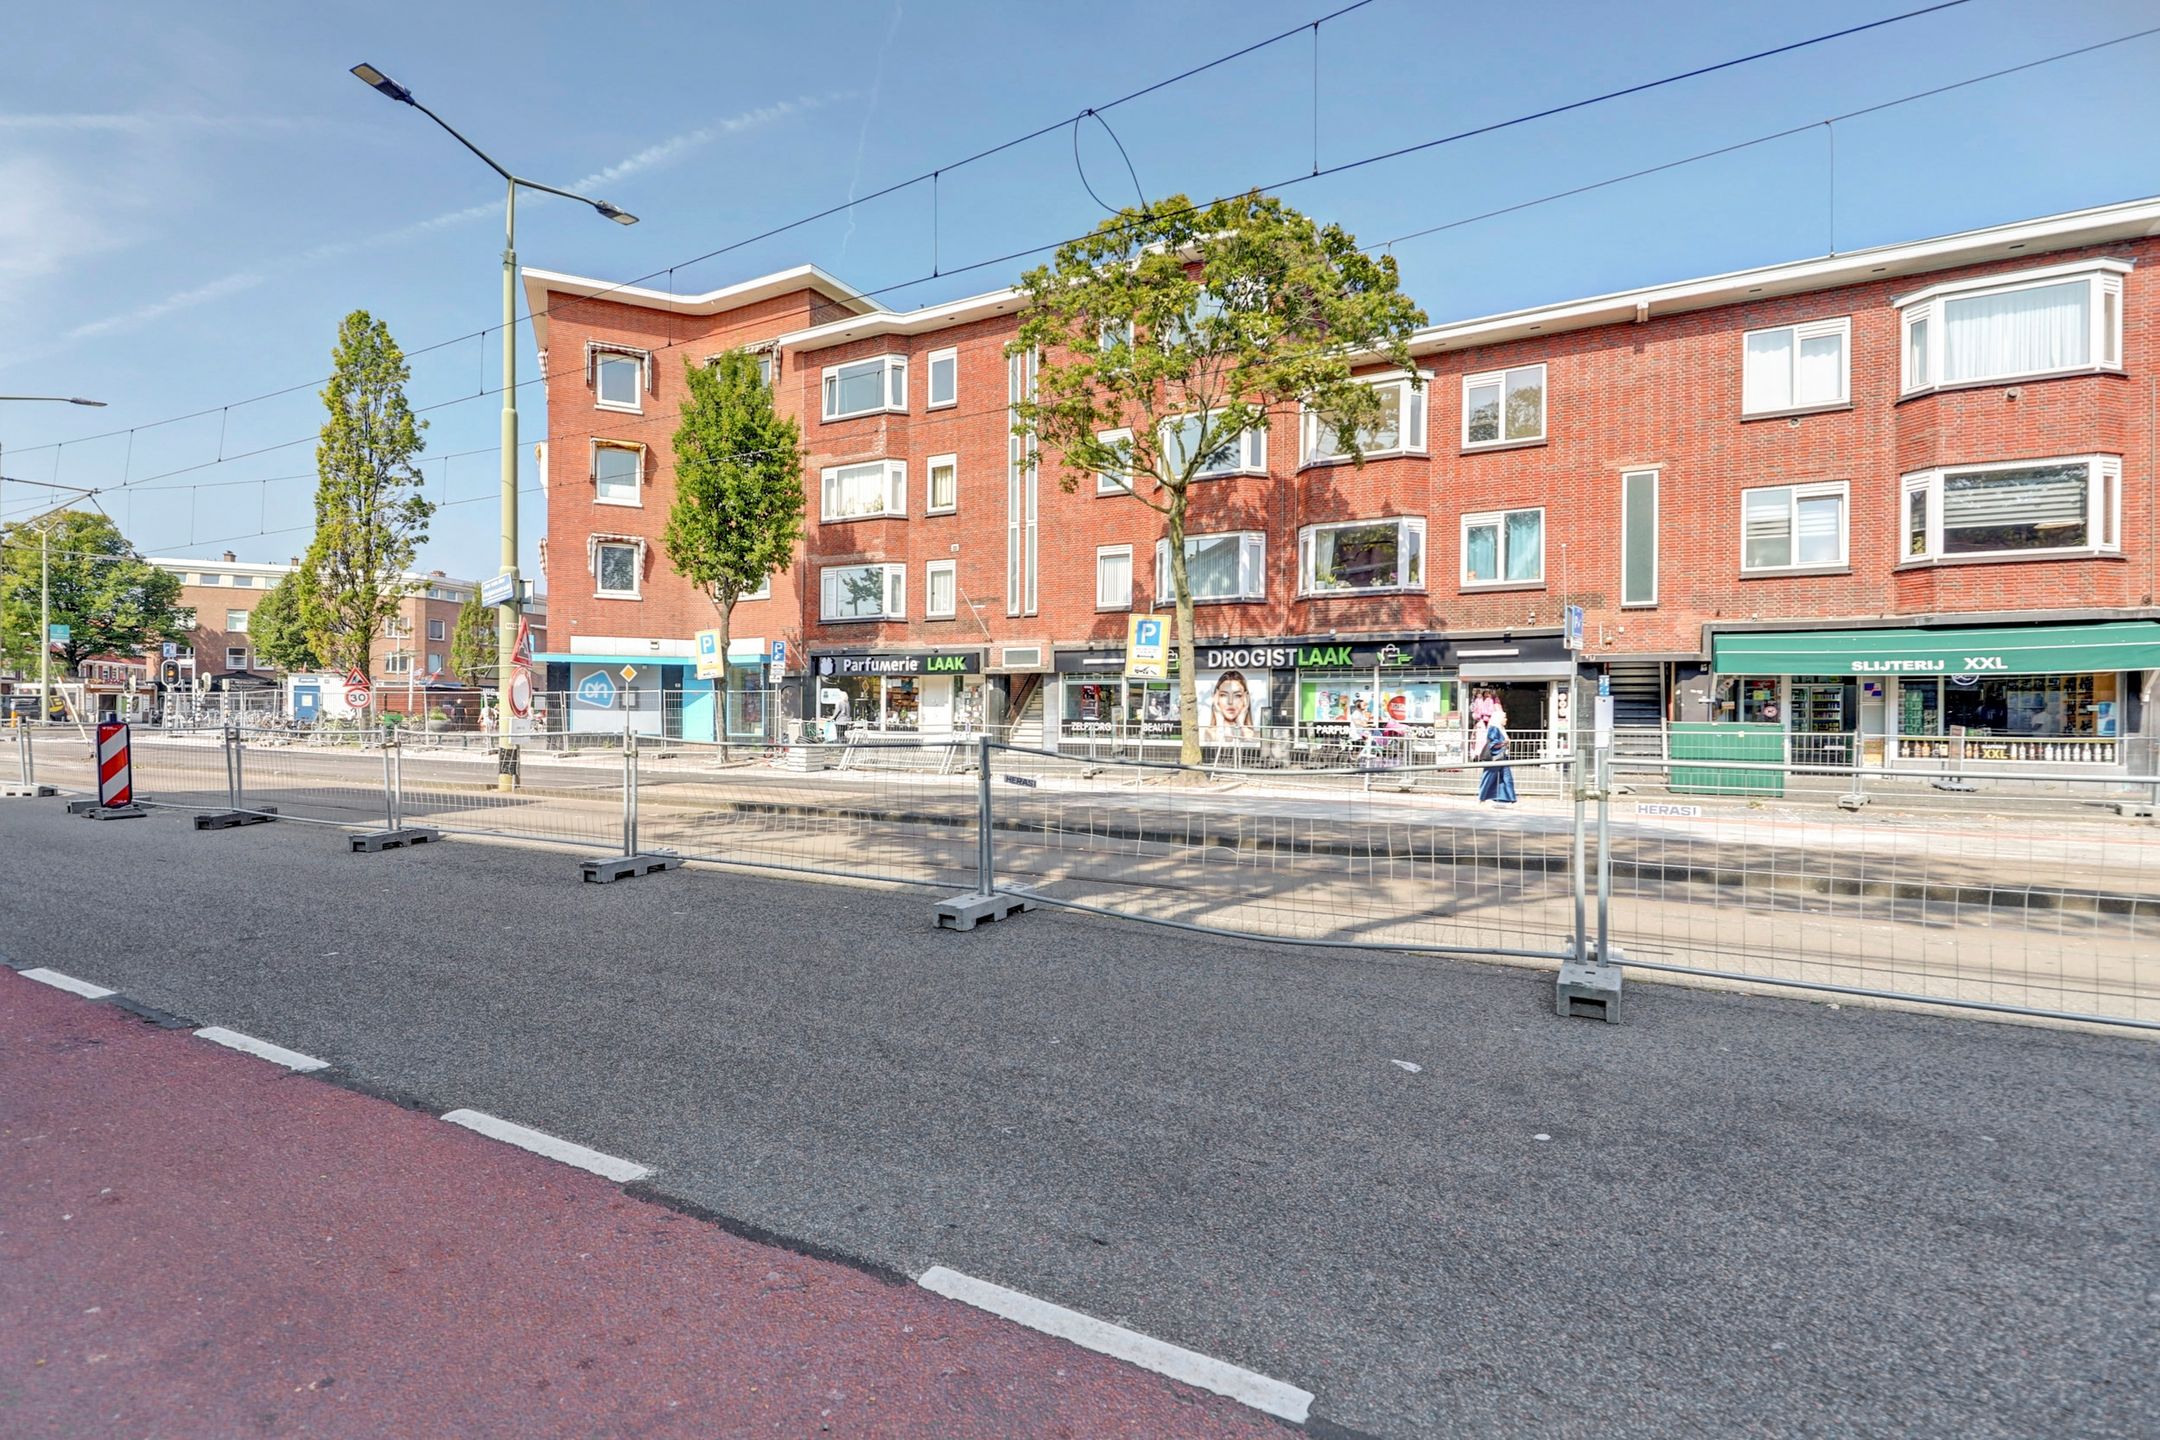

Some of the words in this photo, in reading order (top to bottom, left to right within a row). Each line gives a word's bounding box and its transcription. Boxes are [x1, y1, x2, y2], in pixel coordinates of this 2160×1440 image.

[1141, 623, 1157, 643] P
[703, 637, 712, 651] P
[843, 655, 918, 672] Parfumerie
[927, 656, 966, 671] LAAK
[1851, 660, 1945, 671] SLIJTERIJ
[1964, 657, 2008, 670] XXL
[350, 693, 366, 702] 30
[1143, 723, 1174, 732] BEAUTY
[1983, 749, 2008, 759] XXL
